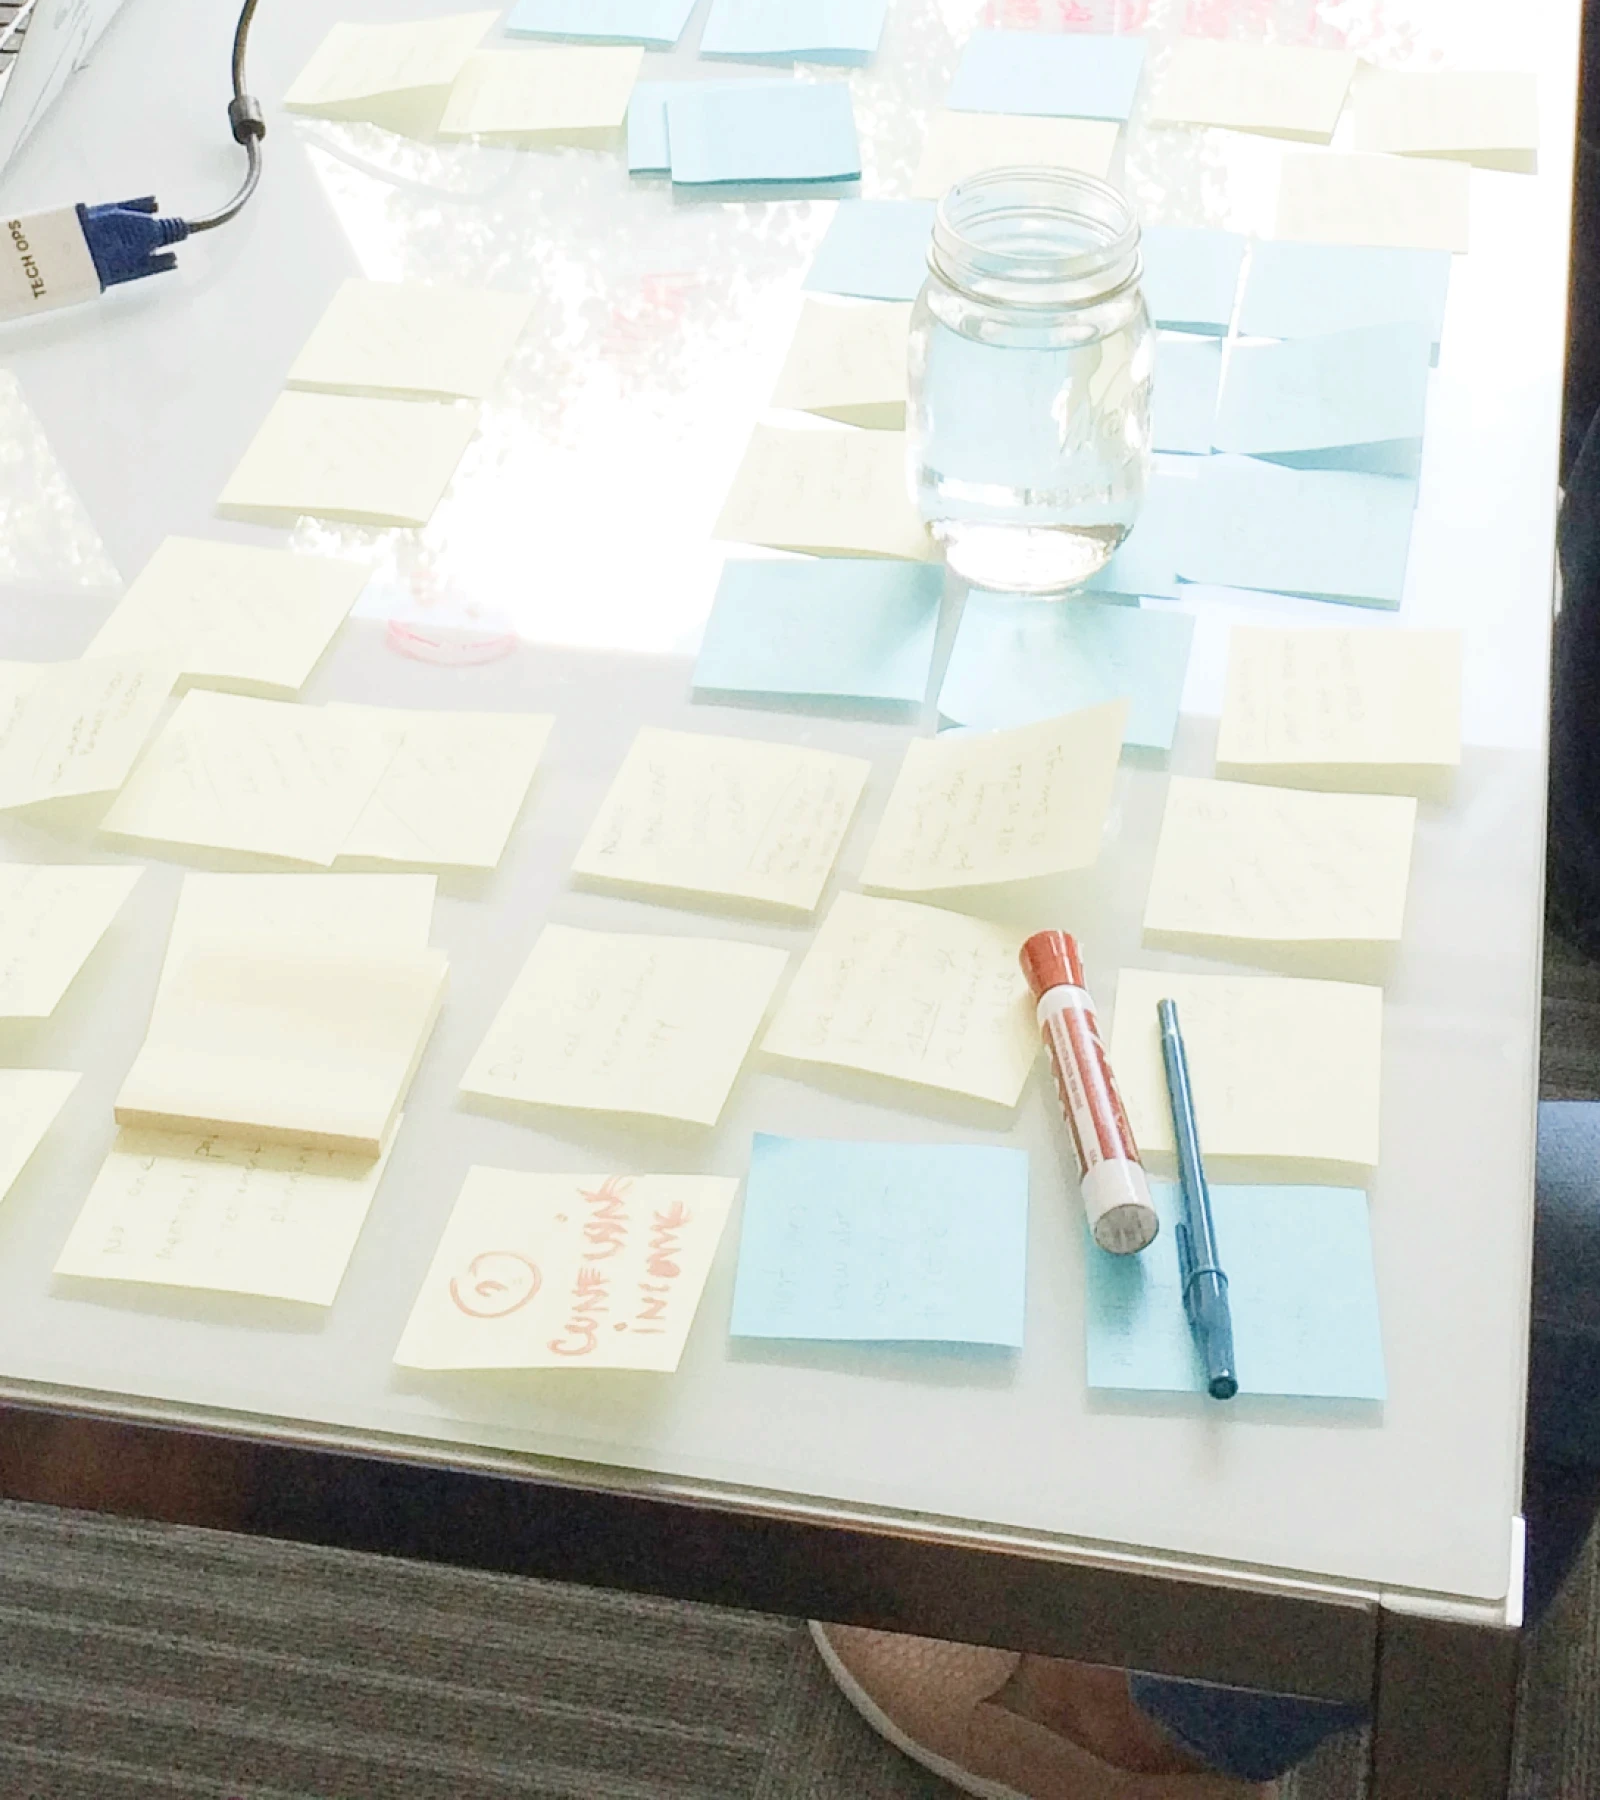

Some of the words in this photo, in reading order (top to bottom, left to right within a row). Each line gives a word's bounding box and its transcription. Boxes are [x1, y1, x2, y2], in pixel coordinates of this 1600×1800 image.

[7, 218, 30, 252] OPS
[21, 254, 48, 301] TECH
[102, 1225, 126, 1256] No
